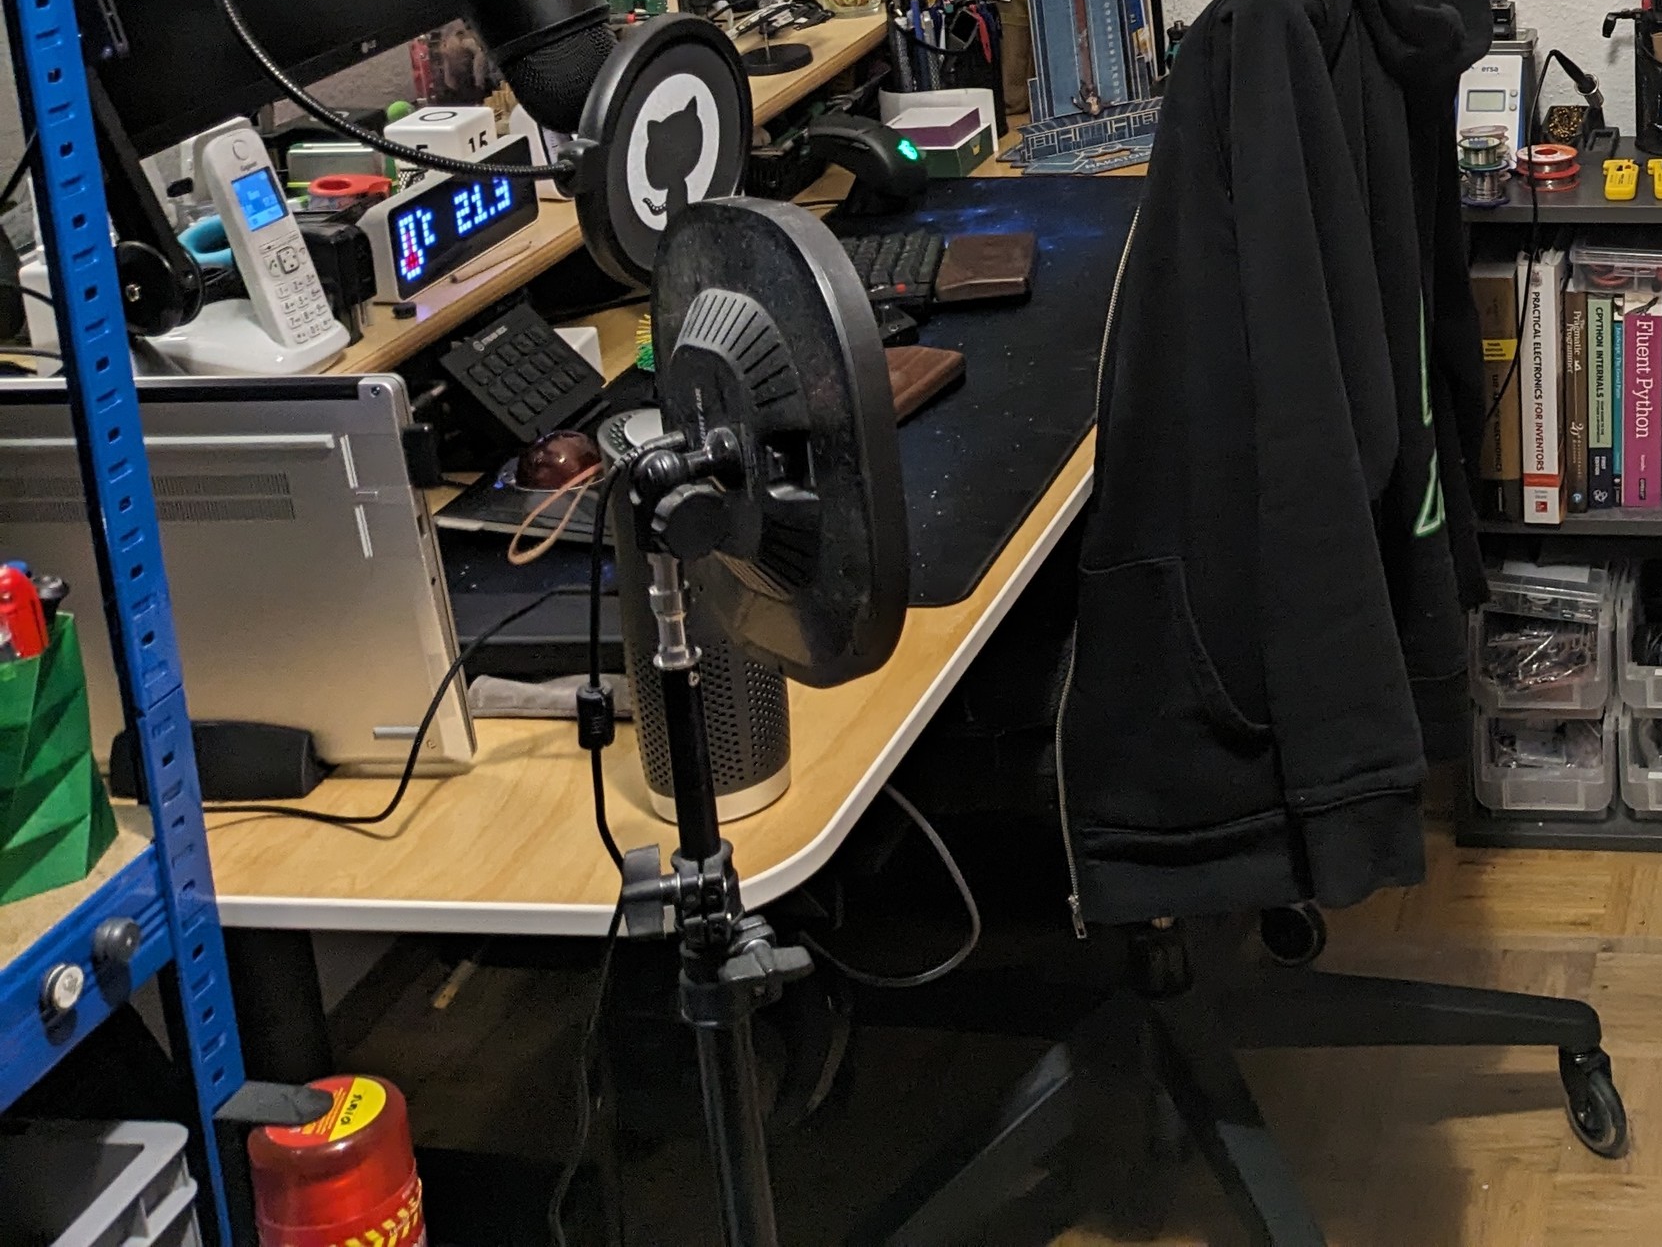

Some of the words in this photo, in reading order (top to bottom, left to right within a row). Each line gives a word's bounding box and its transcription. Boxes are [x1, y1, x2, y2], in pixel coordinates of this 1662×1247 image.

[1481, 65, 1499, 74] ersa
[1532, 291, 1541, 339] PRACTICAL
[1573, 310, 1583, 356] Pragmatic
[1595, 306, 1604, 348] CPYTHON
[1532, 342, 1543, 400] ELECTRONICS
[1636, 320, 1654, 375] Fluent
[1596, 350, 1604, 398] INTERNALS
[1534, 403, 1543, 420] FOR
[1631, 377, 1653, 439] Python
[1534, 422, 1545, 471] INVENTORS
